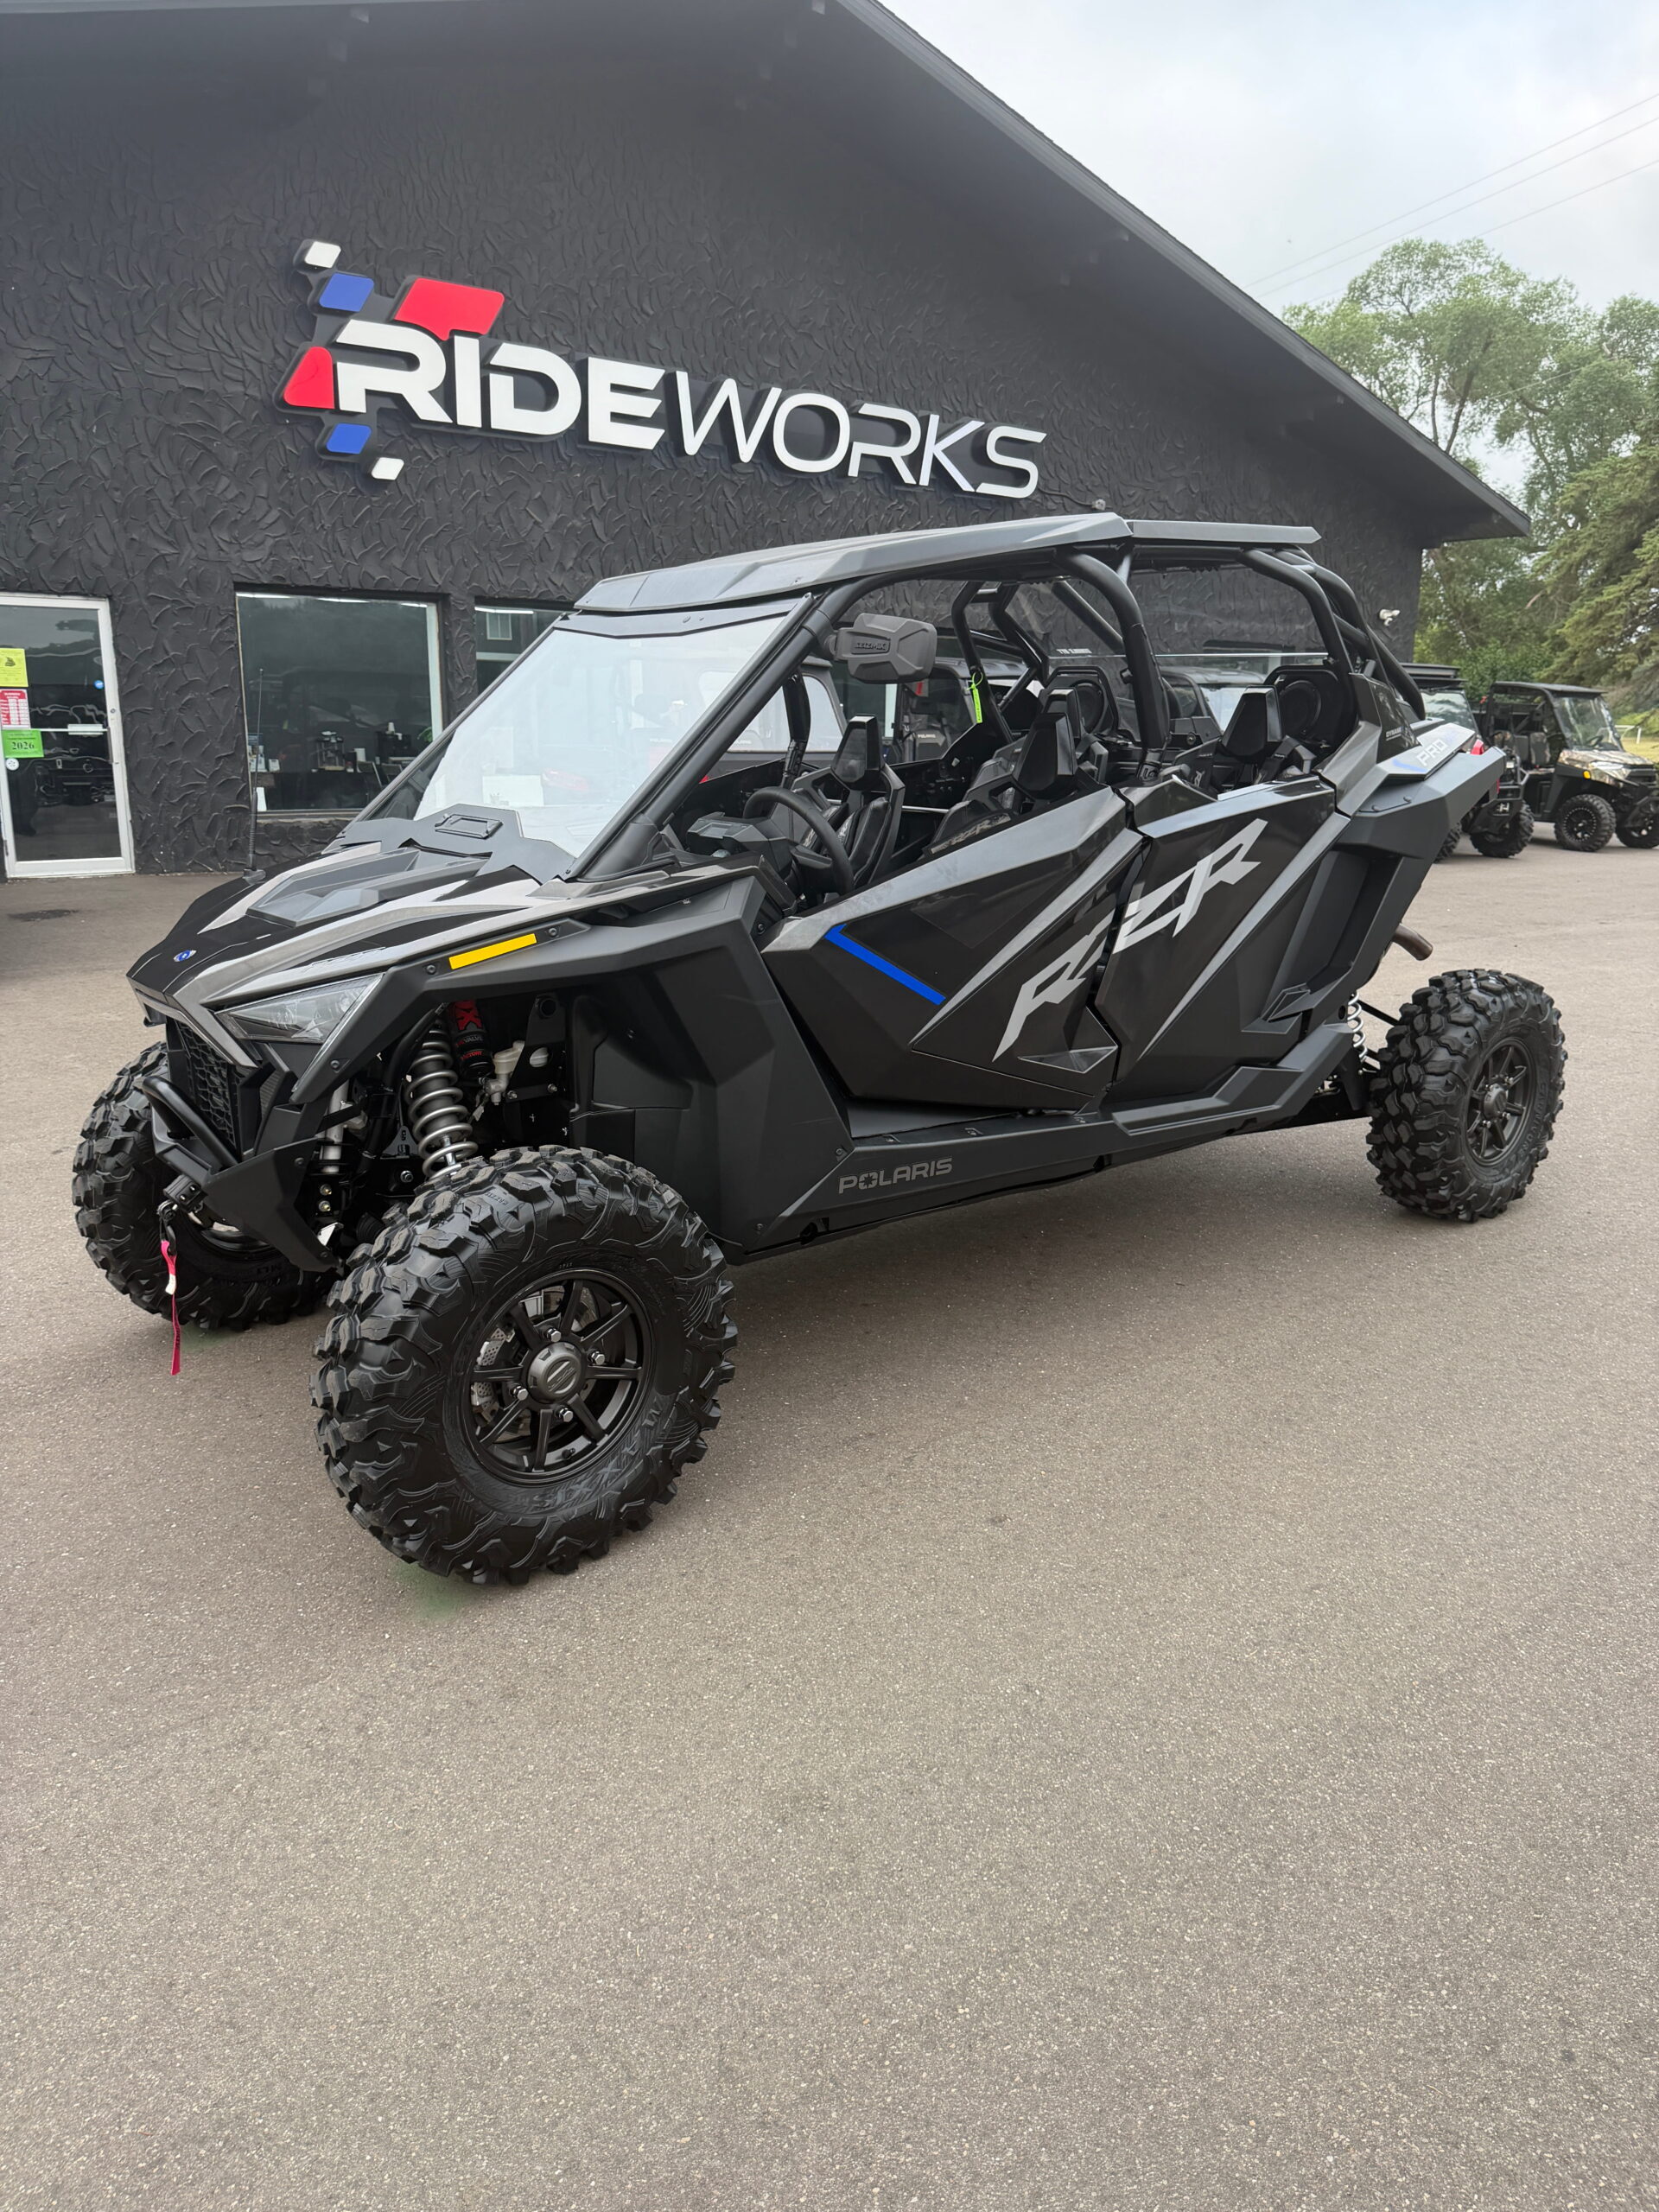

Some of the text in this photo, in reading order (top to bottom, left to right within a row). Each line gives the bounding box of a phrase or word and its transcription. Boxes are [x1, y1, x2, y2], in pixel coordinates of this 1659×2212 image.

[334, 319, 1047, 499] RIDEWORKS
[12, 741, 35, 750] 2026
[1416, 738, 1448, 767] PRO
[991, 817, 1268, 1064] RZR
[838, 1157, 953, 1194] POLARIS
